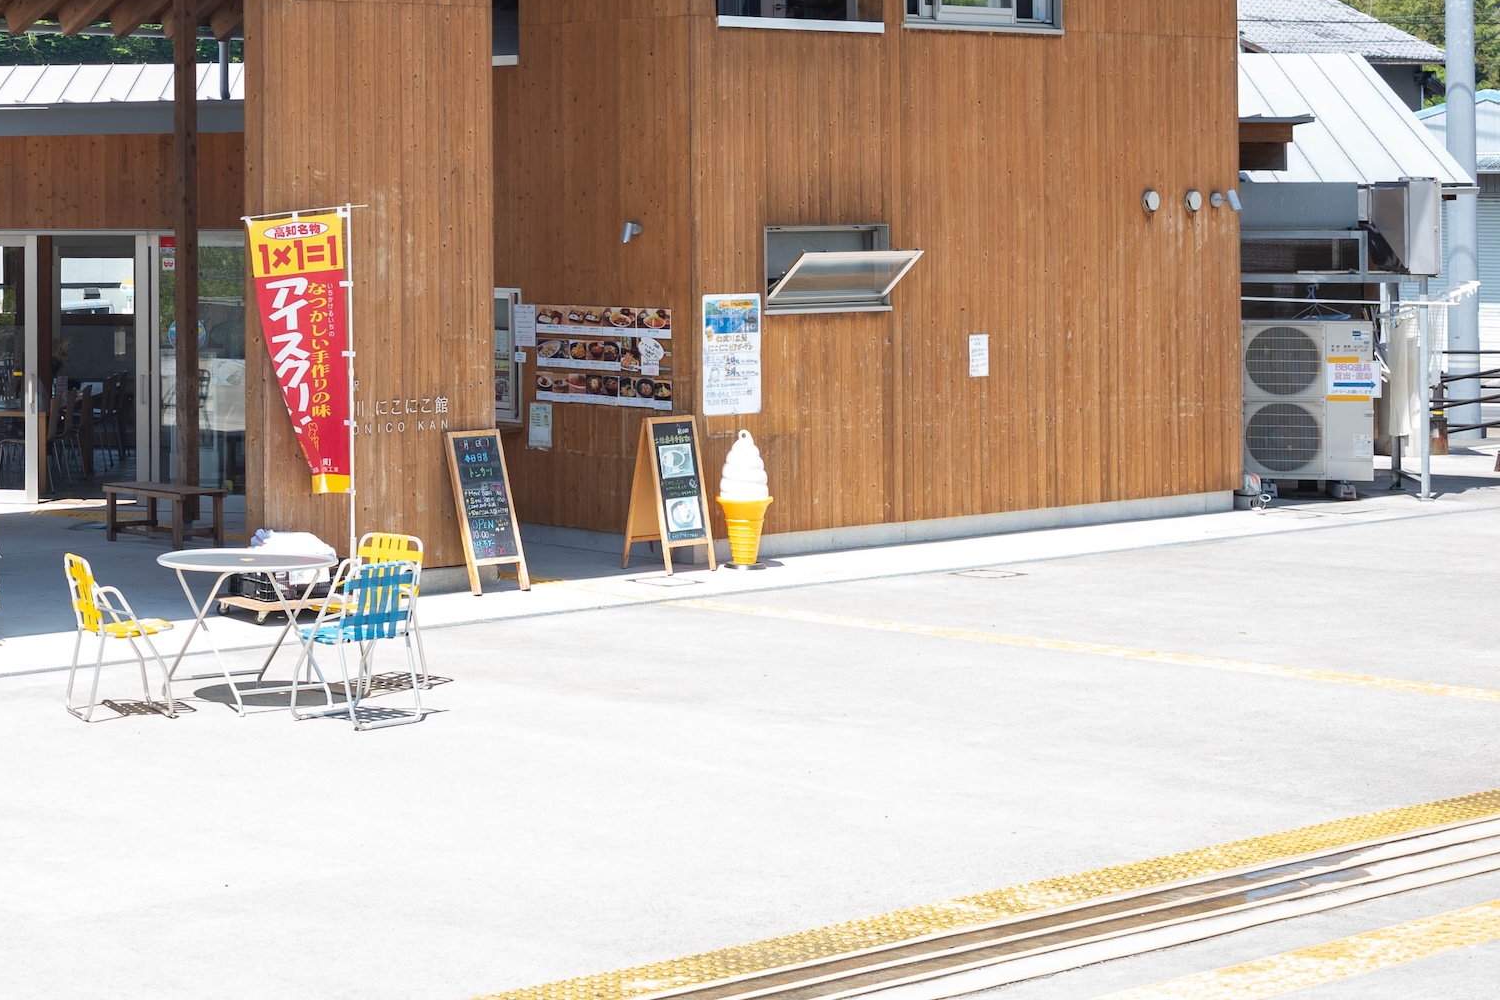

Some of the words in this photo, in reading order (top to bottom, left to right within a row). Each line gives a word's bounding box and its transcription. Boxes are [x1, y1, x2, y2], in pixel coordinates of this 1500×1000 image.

[274, 223, 321, 238] 高知名物
[327, 283, 336, 337] いちかけるいちの
[307, 282, 331, 418] なつかしい手作りの味
[1335, 363, 1371, 371] BBQ道具
[375, 396, 448, 416] にこにこ館
[418, 420, 448, 431] KAN
[469, 466, 493, 478] トンカツ
